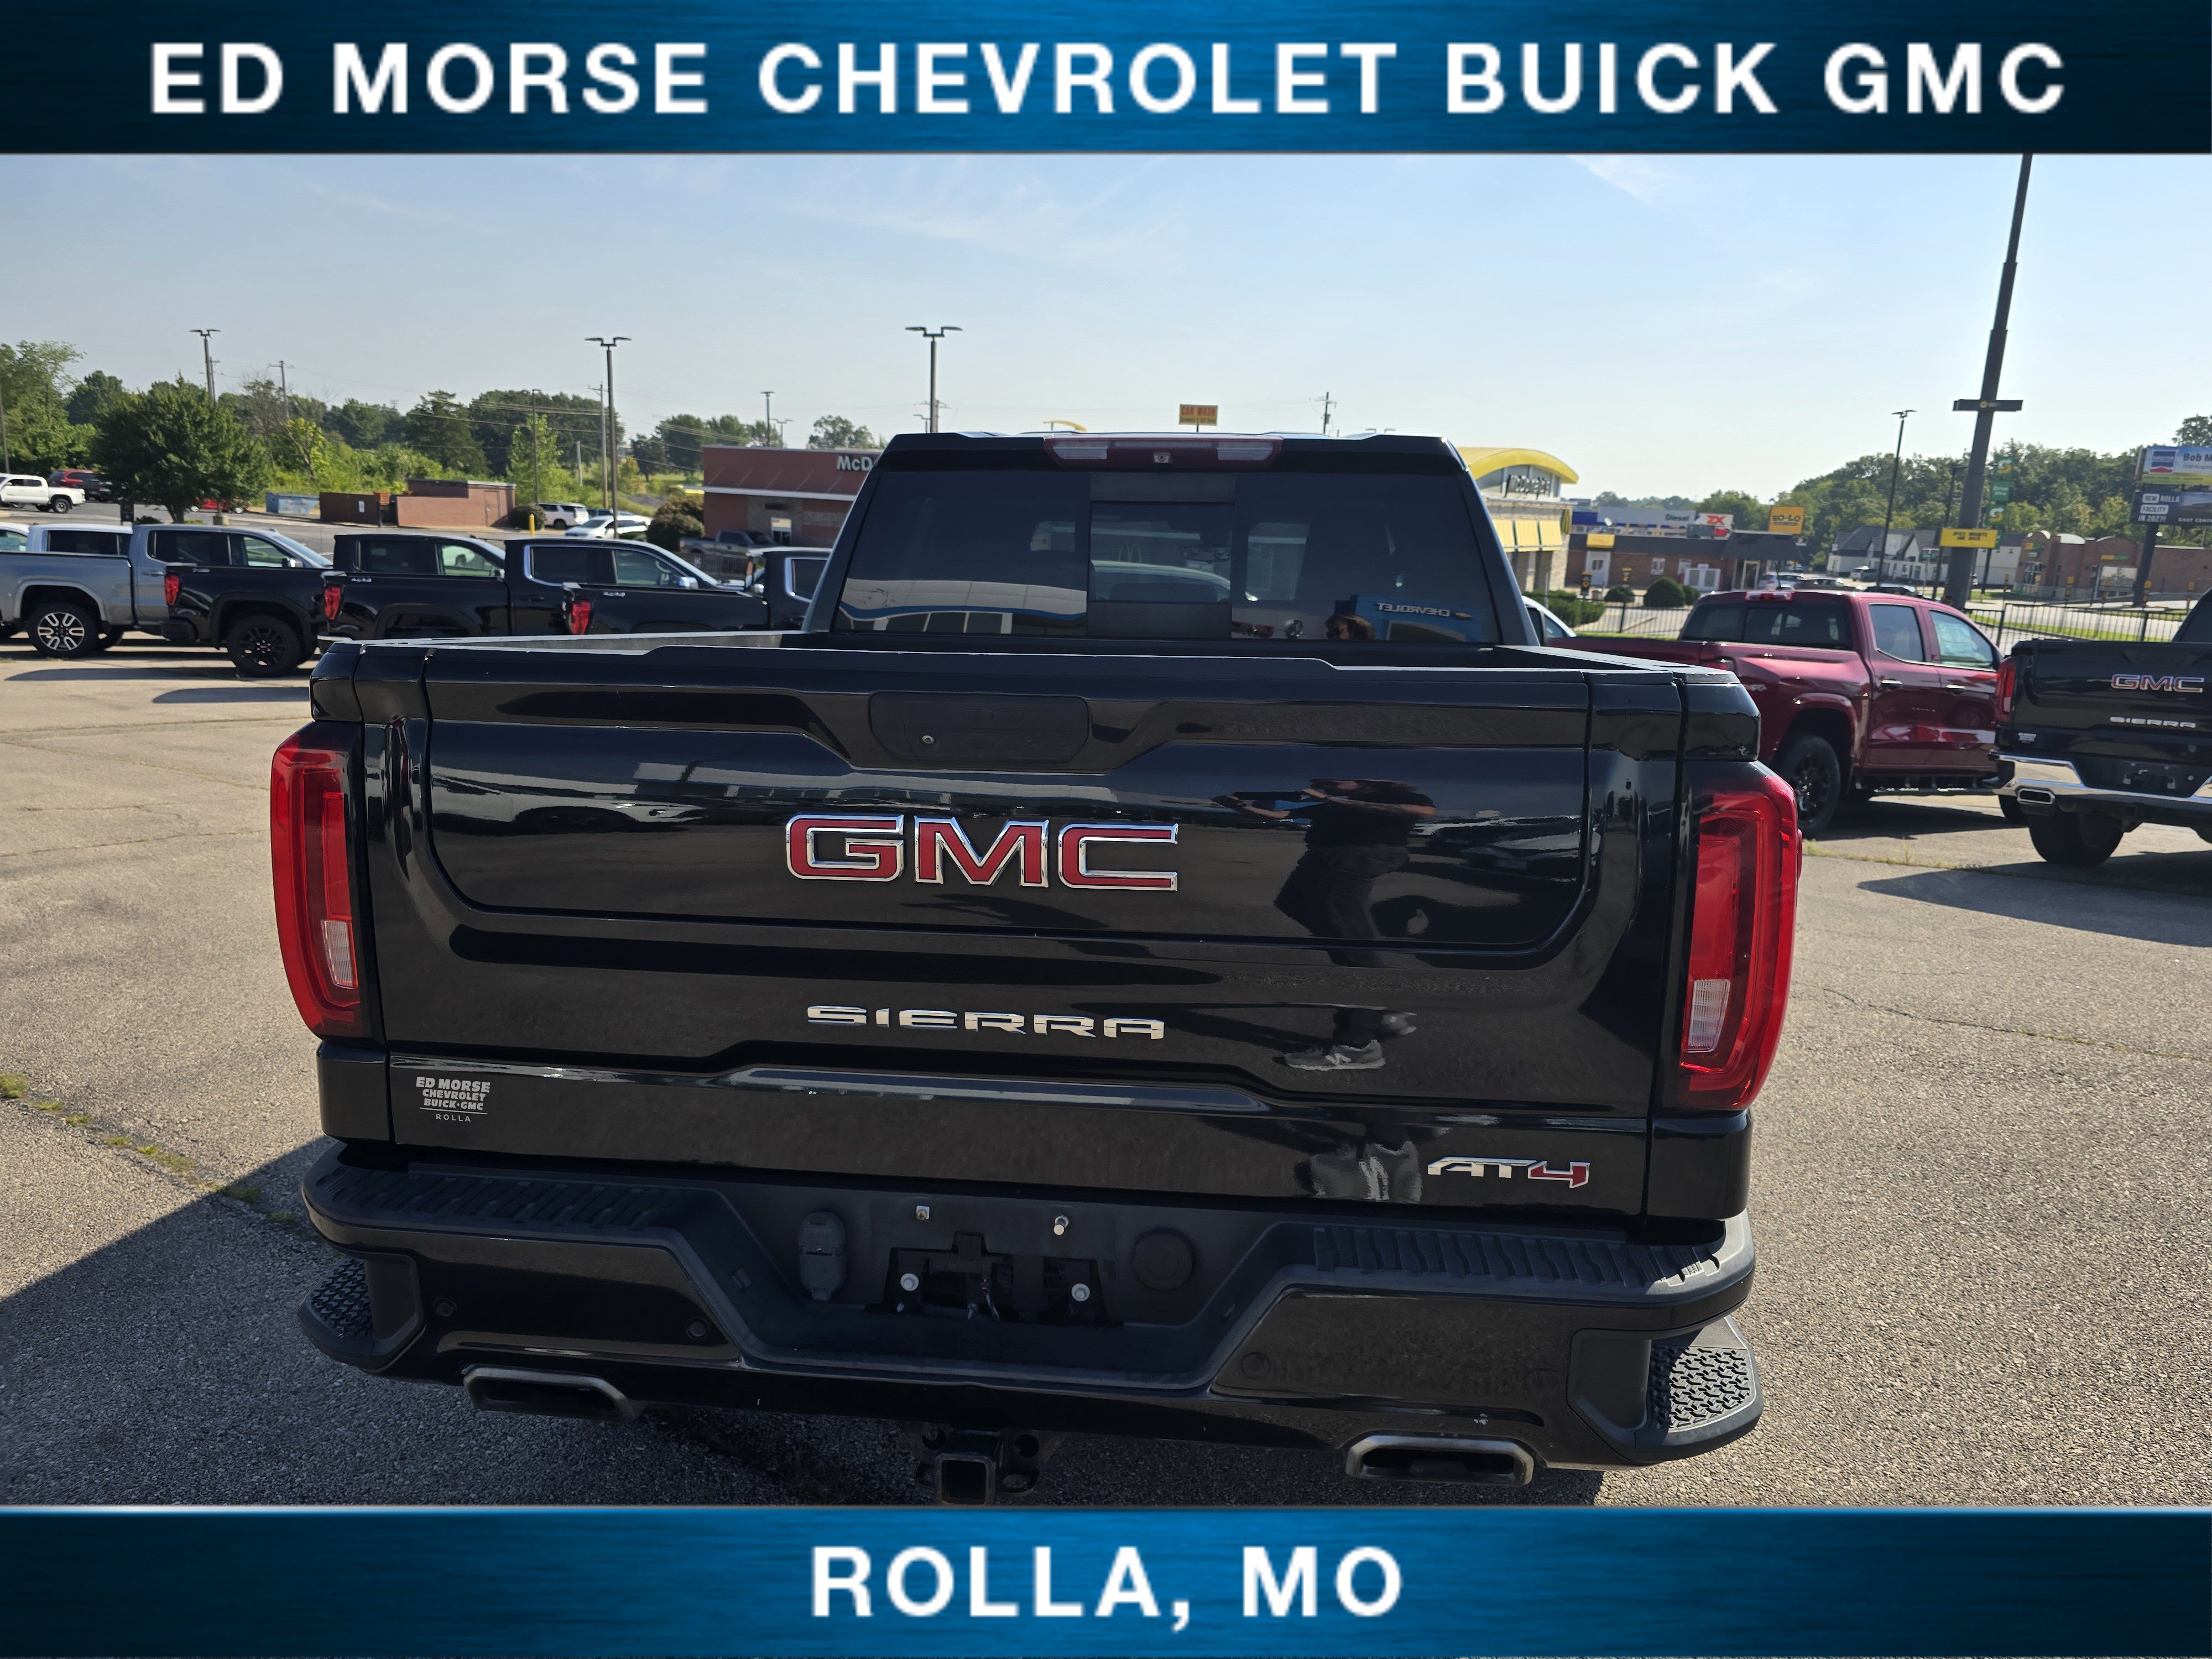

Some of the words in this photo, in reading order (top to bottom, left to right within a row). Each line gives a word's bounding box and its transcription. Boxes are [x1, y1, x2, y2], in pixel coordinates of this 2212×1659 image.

[2183, 453, 2202, 461] Bob
[1665, 513, 1690, 521] Diesel
[2110, 674, 2205, 693] GMC
[2110, 716, 2196, 729] SIERRA
[785, 813, 1179, 892] GMC
[807, 1005, 1165, 1040] SIERRA
[416, 1076, 436, 1088] ED
[438, 1078, 491, 1093] MORSE
[422, 1088, 486, 1102] CHEVROLET
[435, 1113, 471, 1122] ROLLA
[1427, 1156, 1590, 1189] AT4
